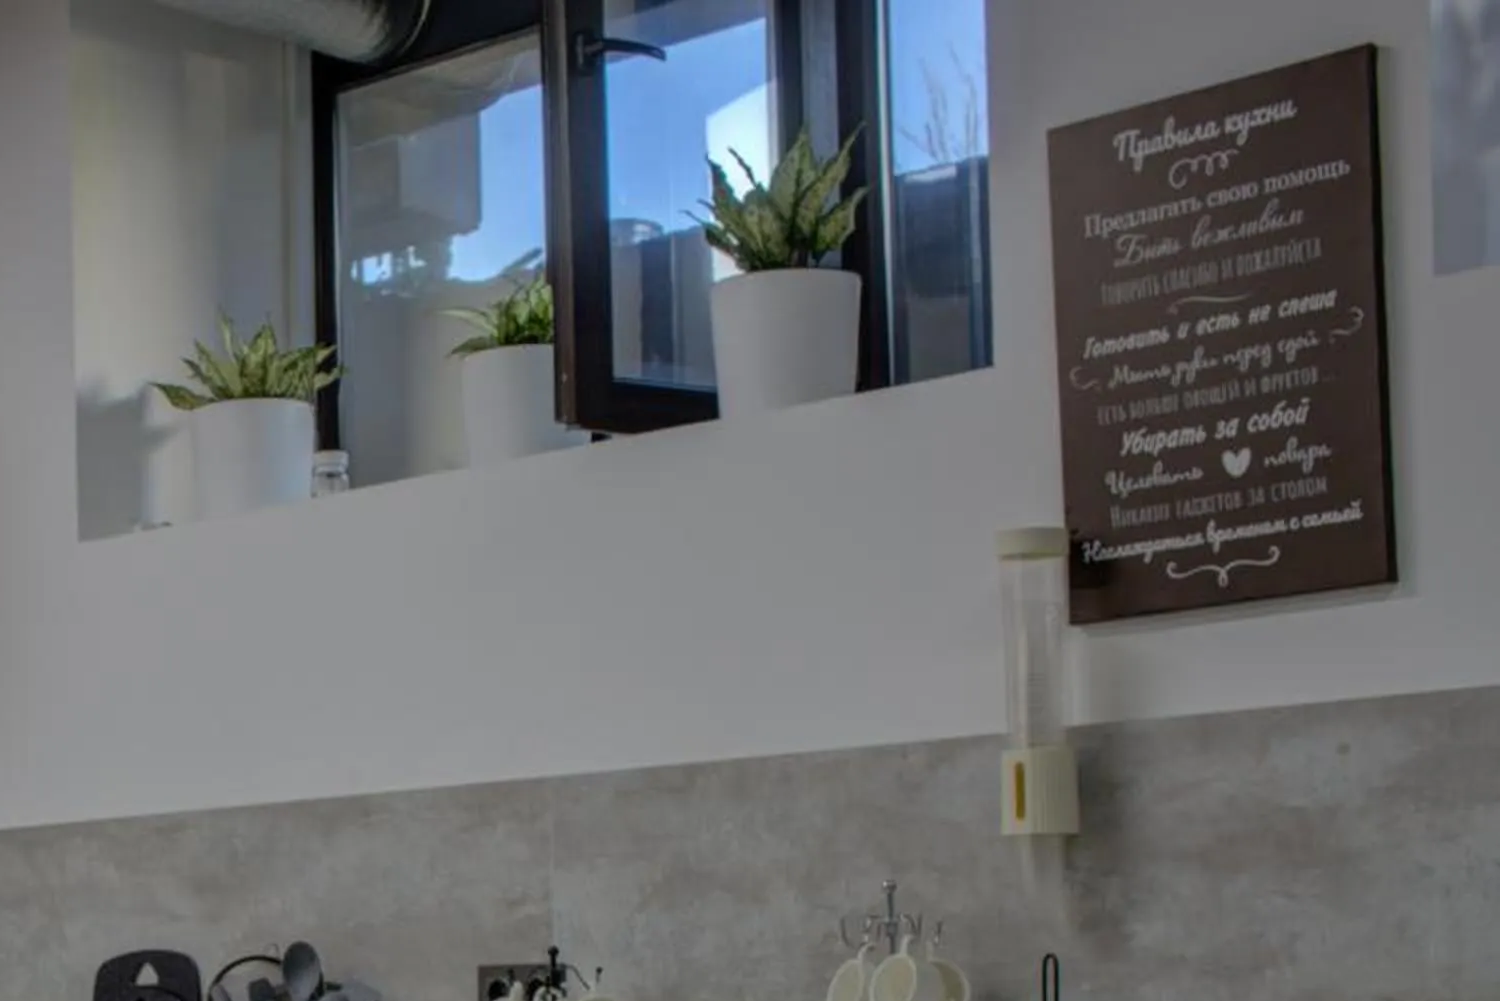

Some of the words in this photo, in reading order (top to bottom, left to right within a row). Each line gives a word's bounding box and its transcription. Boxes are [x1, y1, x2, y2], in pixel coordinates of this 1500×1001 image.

[1113, 115, 1220, 171] Правила
[1225, 99, 1297, 144] кухни
[1084, 195, 1202, 239] Предлагать
[1207, 181, 1258, 208] свою
[1264, 158, 1350, 192] помощь
[1083, 326, 1170, 360] Готовить
[1196, 312, 1240, 336] есть
[1248, 305, 1271, 325] не
[1278, 289, 1338, 318] спеша
[1120, 424, 1206, 458] Убирать
[1213, 417, 1239, 439] за
[1246, 397, 1311, 433] собой
